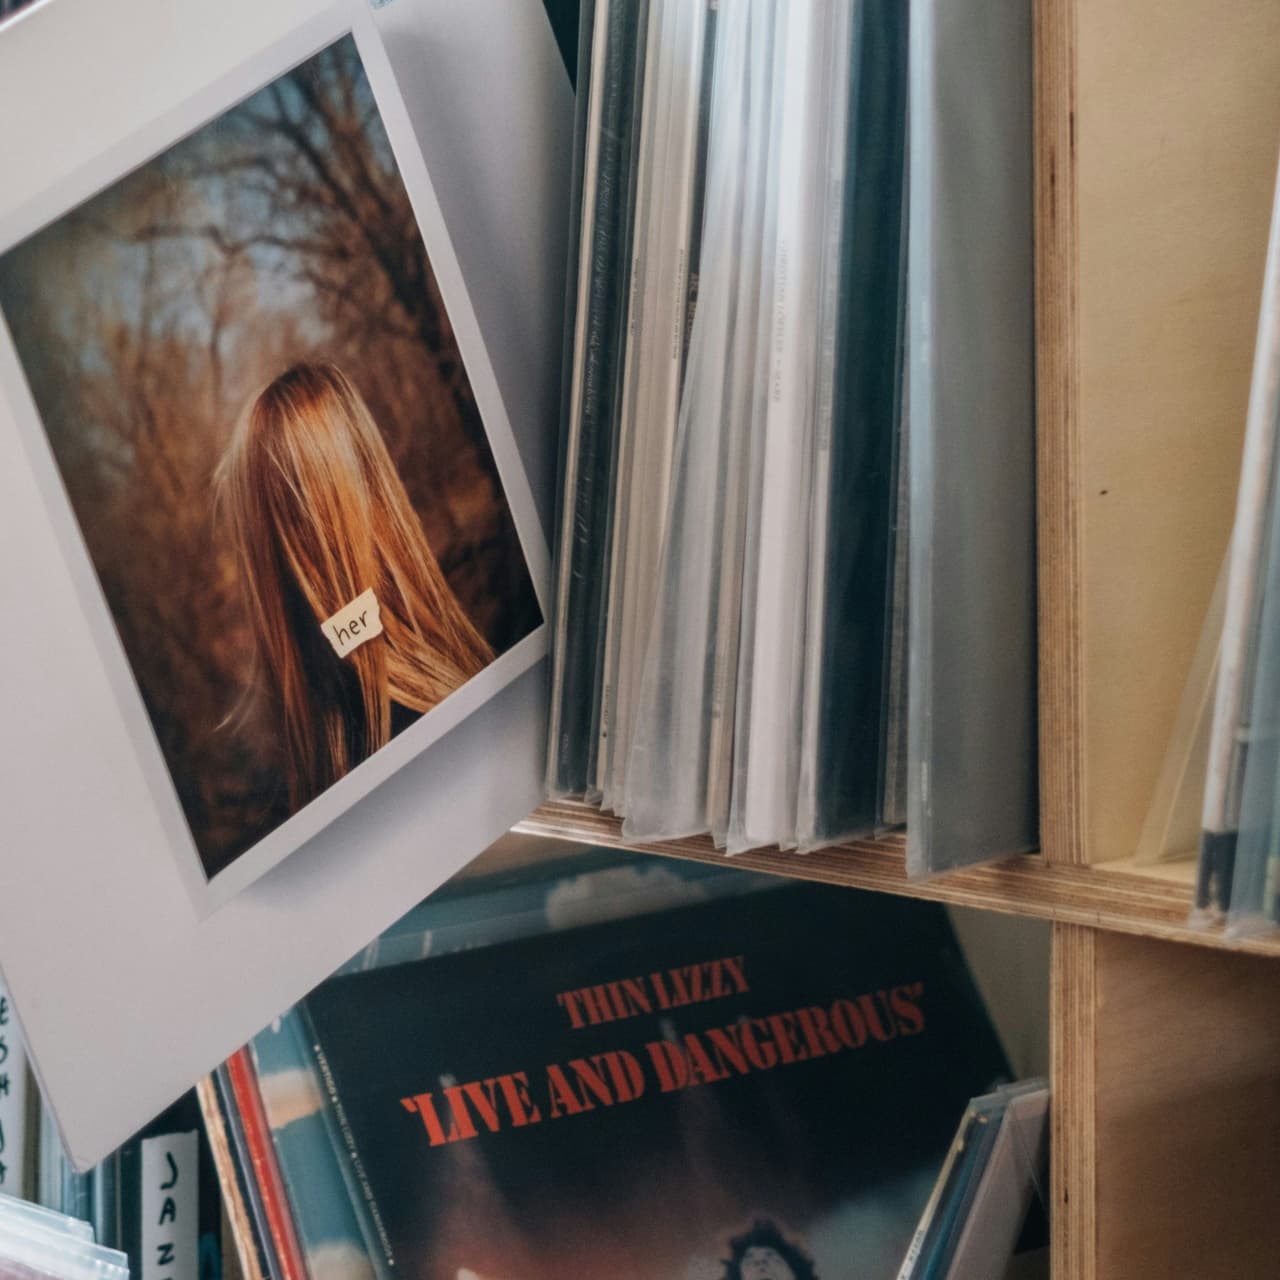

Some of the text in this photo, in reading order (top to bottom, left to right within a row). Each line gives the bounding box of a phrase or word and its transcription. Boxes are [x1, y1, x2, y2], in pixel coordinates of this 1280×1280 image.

[333, 610, 367, 646] her
[556, 956, 750, 1029] THIN LIZZY
[547, 1050, 645, 1119] AND
[157, 1152, 179, 1280] JAZ
